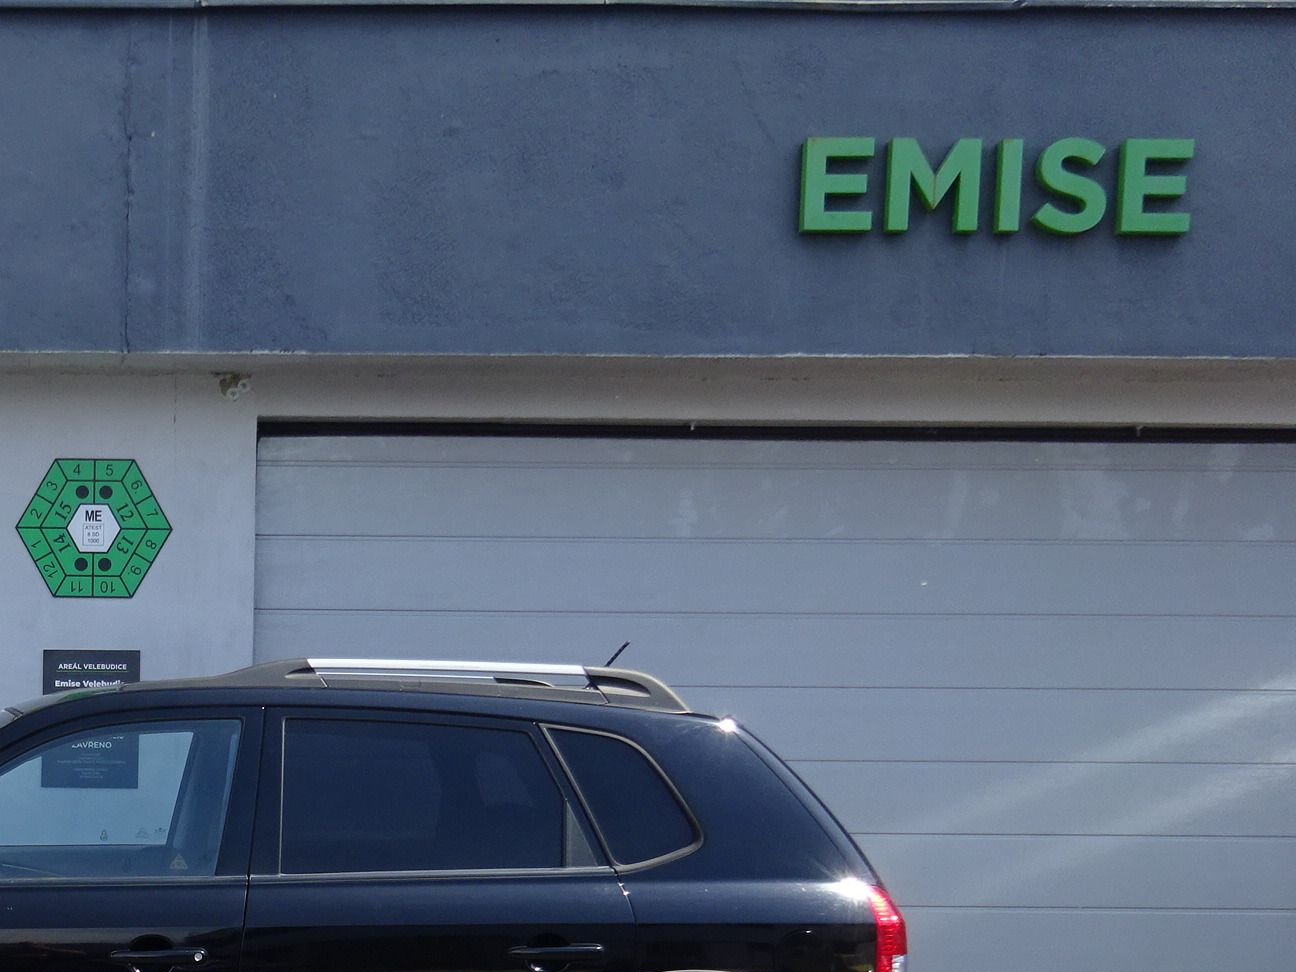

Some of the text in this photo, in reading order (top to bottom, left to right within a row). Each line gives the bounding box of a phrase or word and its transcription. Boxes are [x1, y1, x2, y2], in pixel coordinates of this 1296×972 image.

[799, 136, 1195, 236] EMISE
[72, 463, 81, 476] 4
[105, 463, 114, 477] 5
[46, 480, 58, 491] 3
[30, 508, 42, 520] 2
[54, 500, 72, 521] 15
[85, 510, 102, 522] ME
[115, 503, 134, 522] 12
[145, 508, 158, 518] 7
[31, 540, 42, 548] 1
[54, 533, 71, 553] 14
[116, 535, 134, 554] 13
[145, 539, 157, 549] 8
[43, 560, 59, 579] 12
[70, 581, 84, 593] 11
[100, 581, 116, 593] 10
[58, 662, 127, 671] AREÁL VELEBUDICE
[54, 679, 81, 688] Emise
